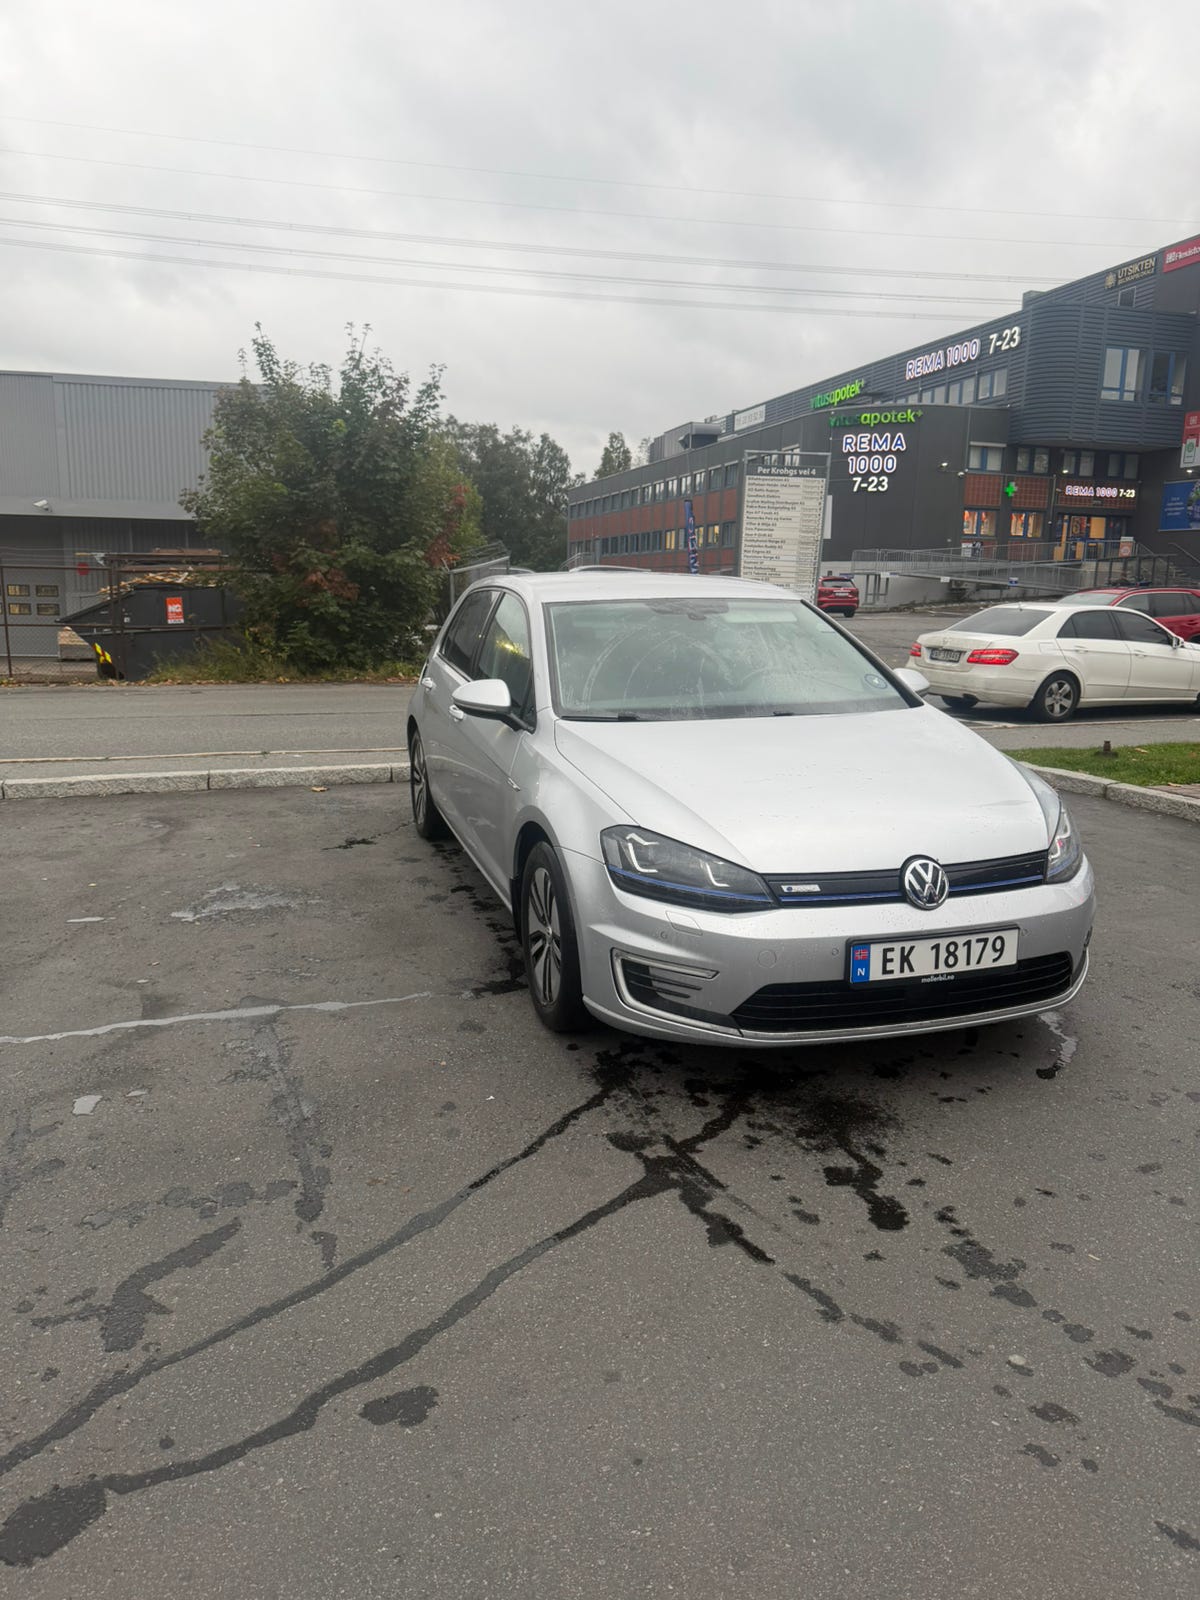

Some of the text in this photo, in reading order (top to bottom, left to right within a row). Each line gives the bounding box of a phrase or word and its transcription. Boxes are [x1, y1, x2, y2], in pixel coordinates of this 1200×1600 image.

[1117, 257, 1156, 279] UTSIKTEN
[905, 325, 1021, 381] REMA 1000 7-23
[842, 432, 907, 454] REMA
[757, 466, 770, 474] Per
[771, 467, 798, 476] Krohgs
[847, 454, 897, 474] 1000
[852, 476, 889, 492] 7-23
[1065, 485, 1136, 498] REMA 1000 7-23
[857, 935, 1006, 977] N EK 18179
